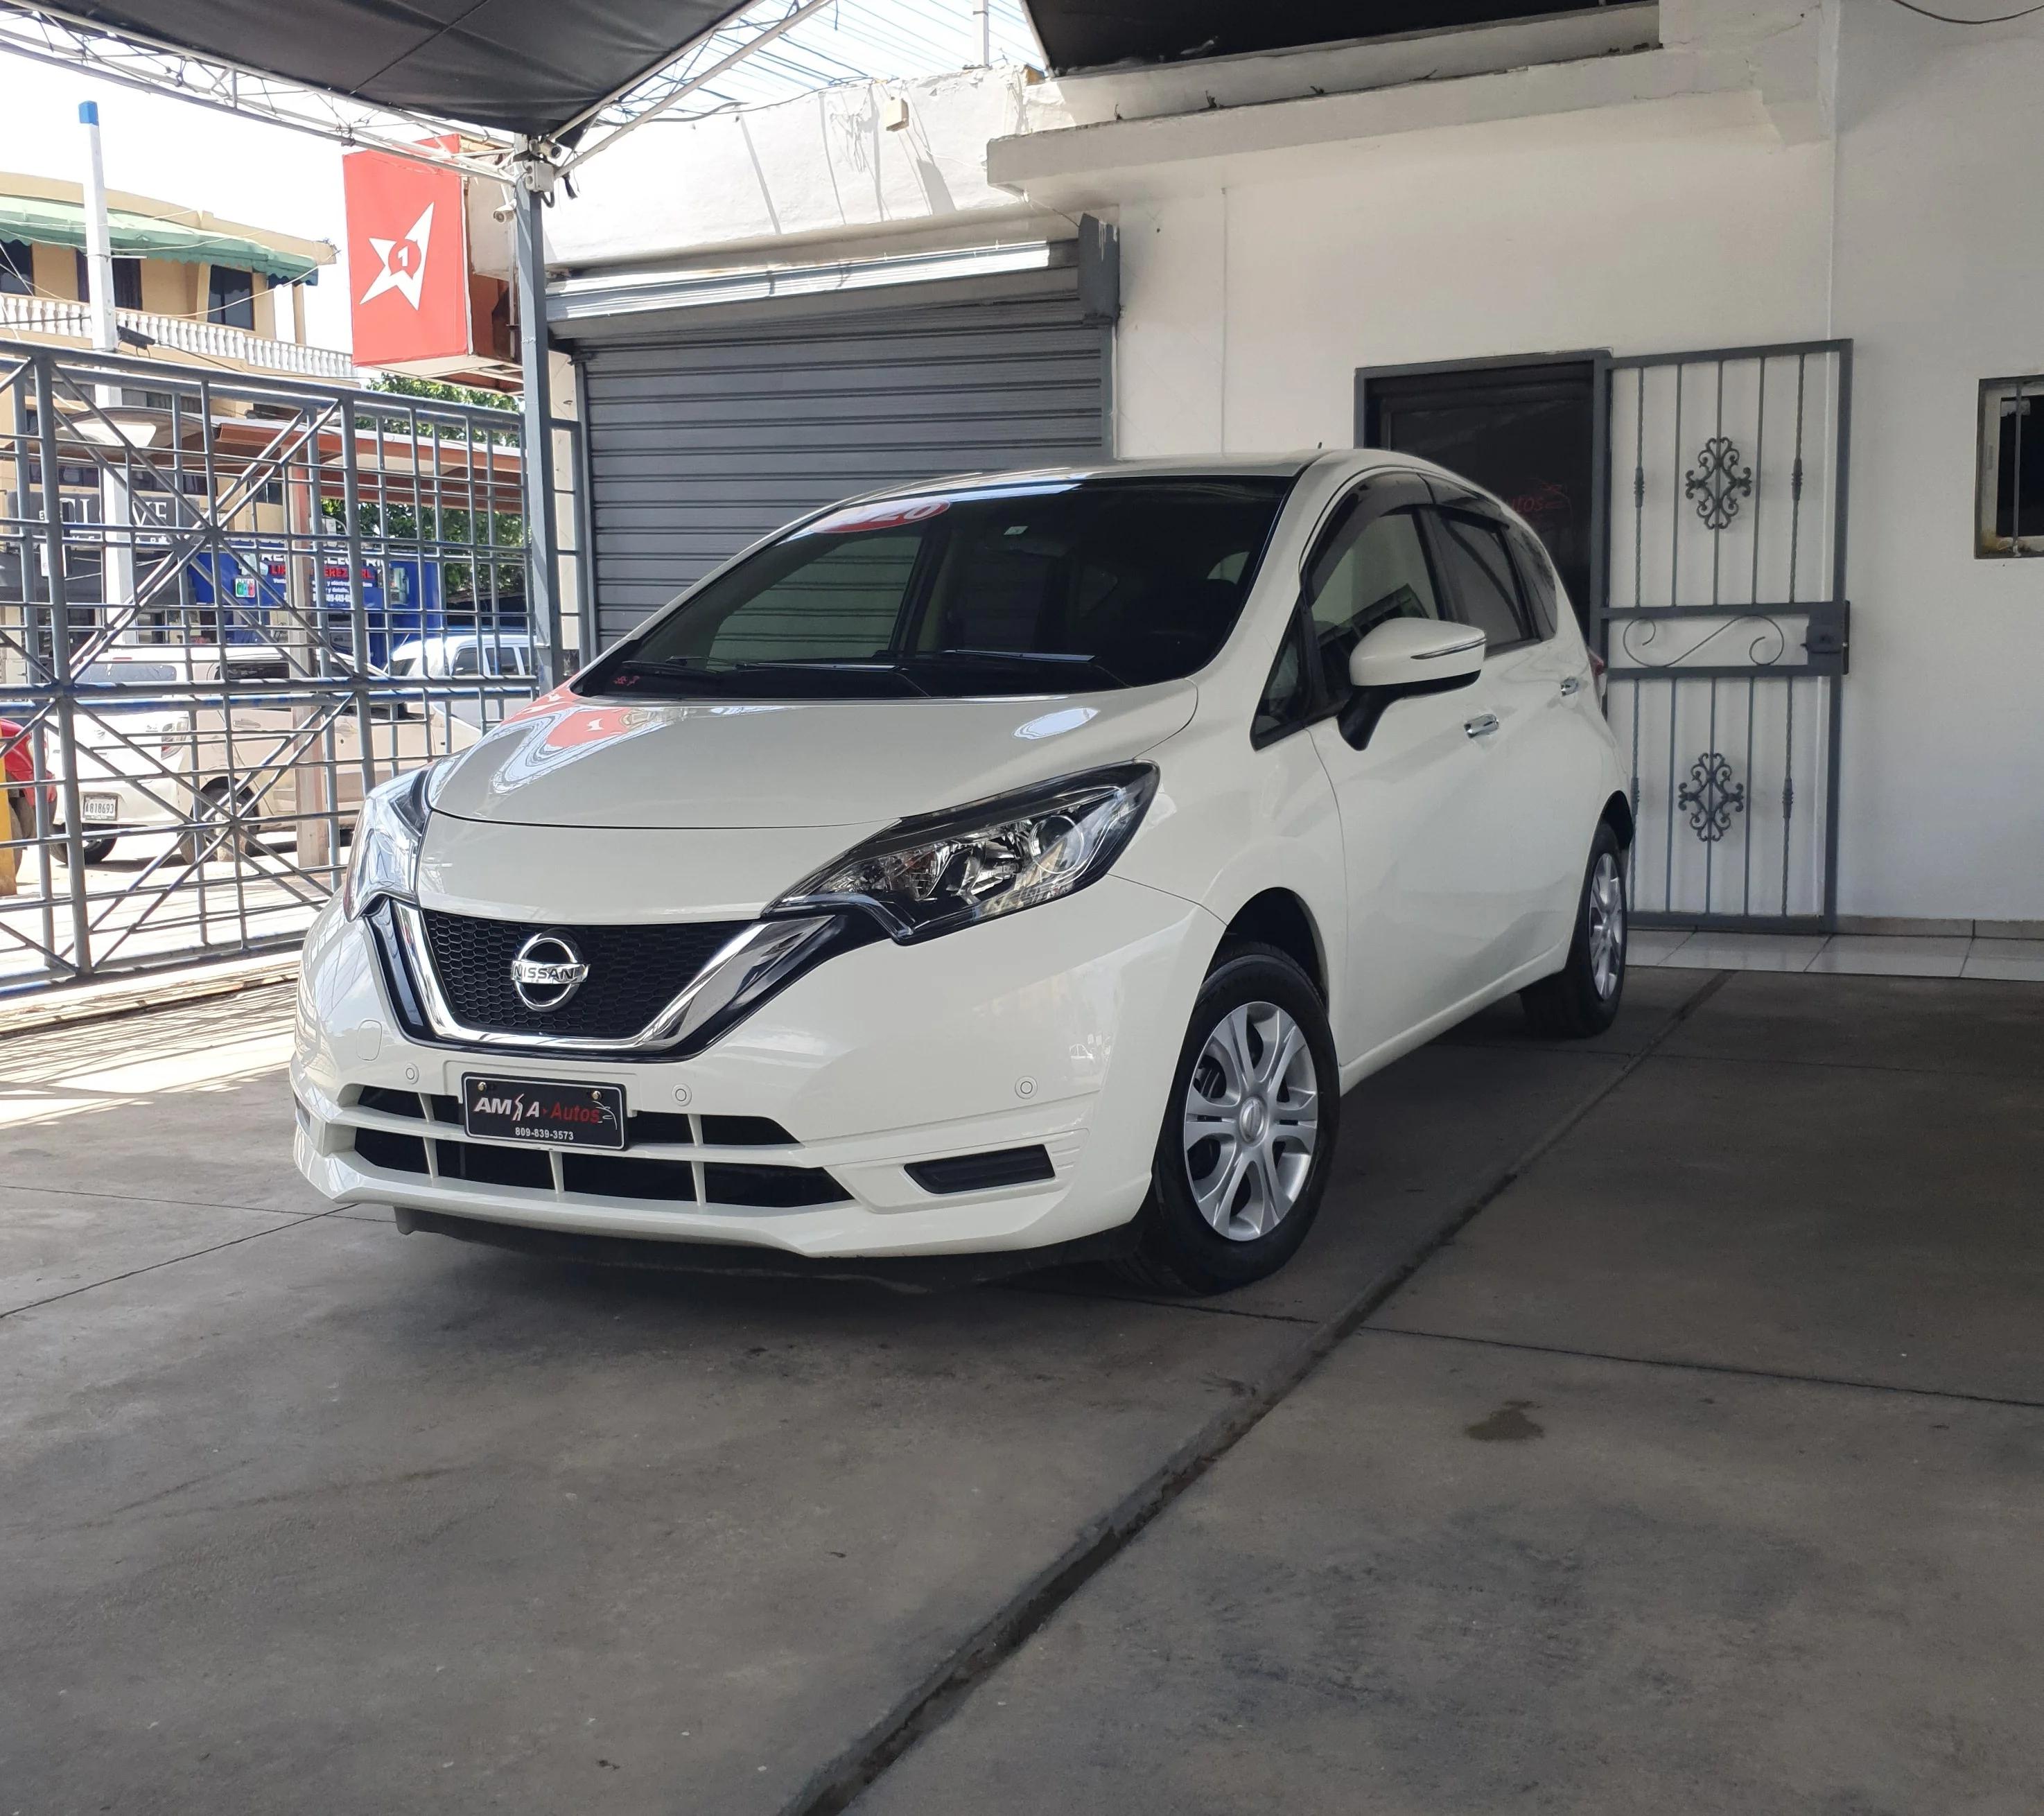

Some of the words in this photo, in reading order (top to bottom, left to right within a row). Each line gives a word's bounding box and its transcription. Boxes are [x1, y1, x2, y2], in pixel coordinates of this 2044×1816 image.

[397, 245, 408, 267] 1
[514, 963, 575, 980] NISSAN
[550, 1102, 600, 1124] Autos
[515, 1126, 575, 1141] 809-839-3573
